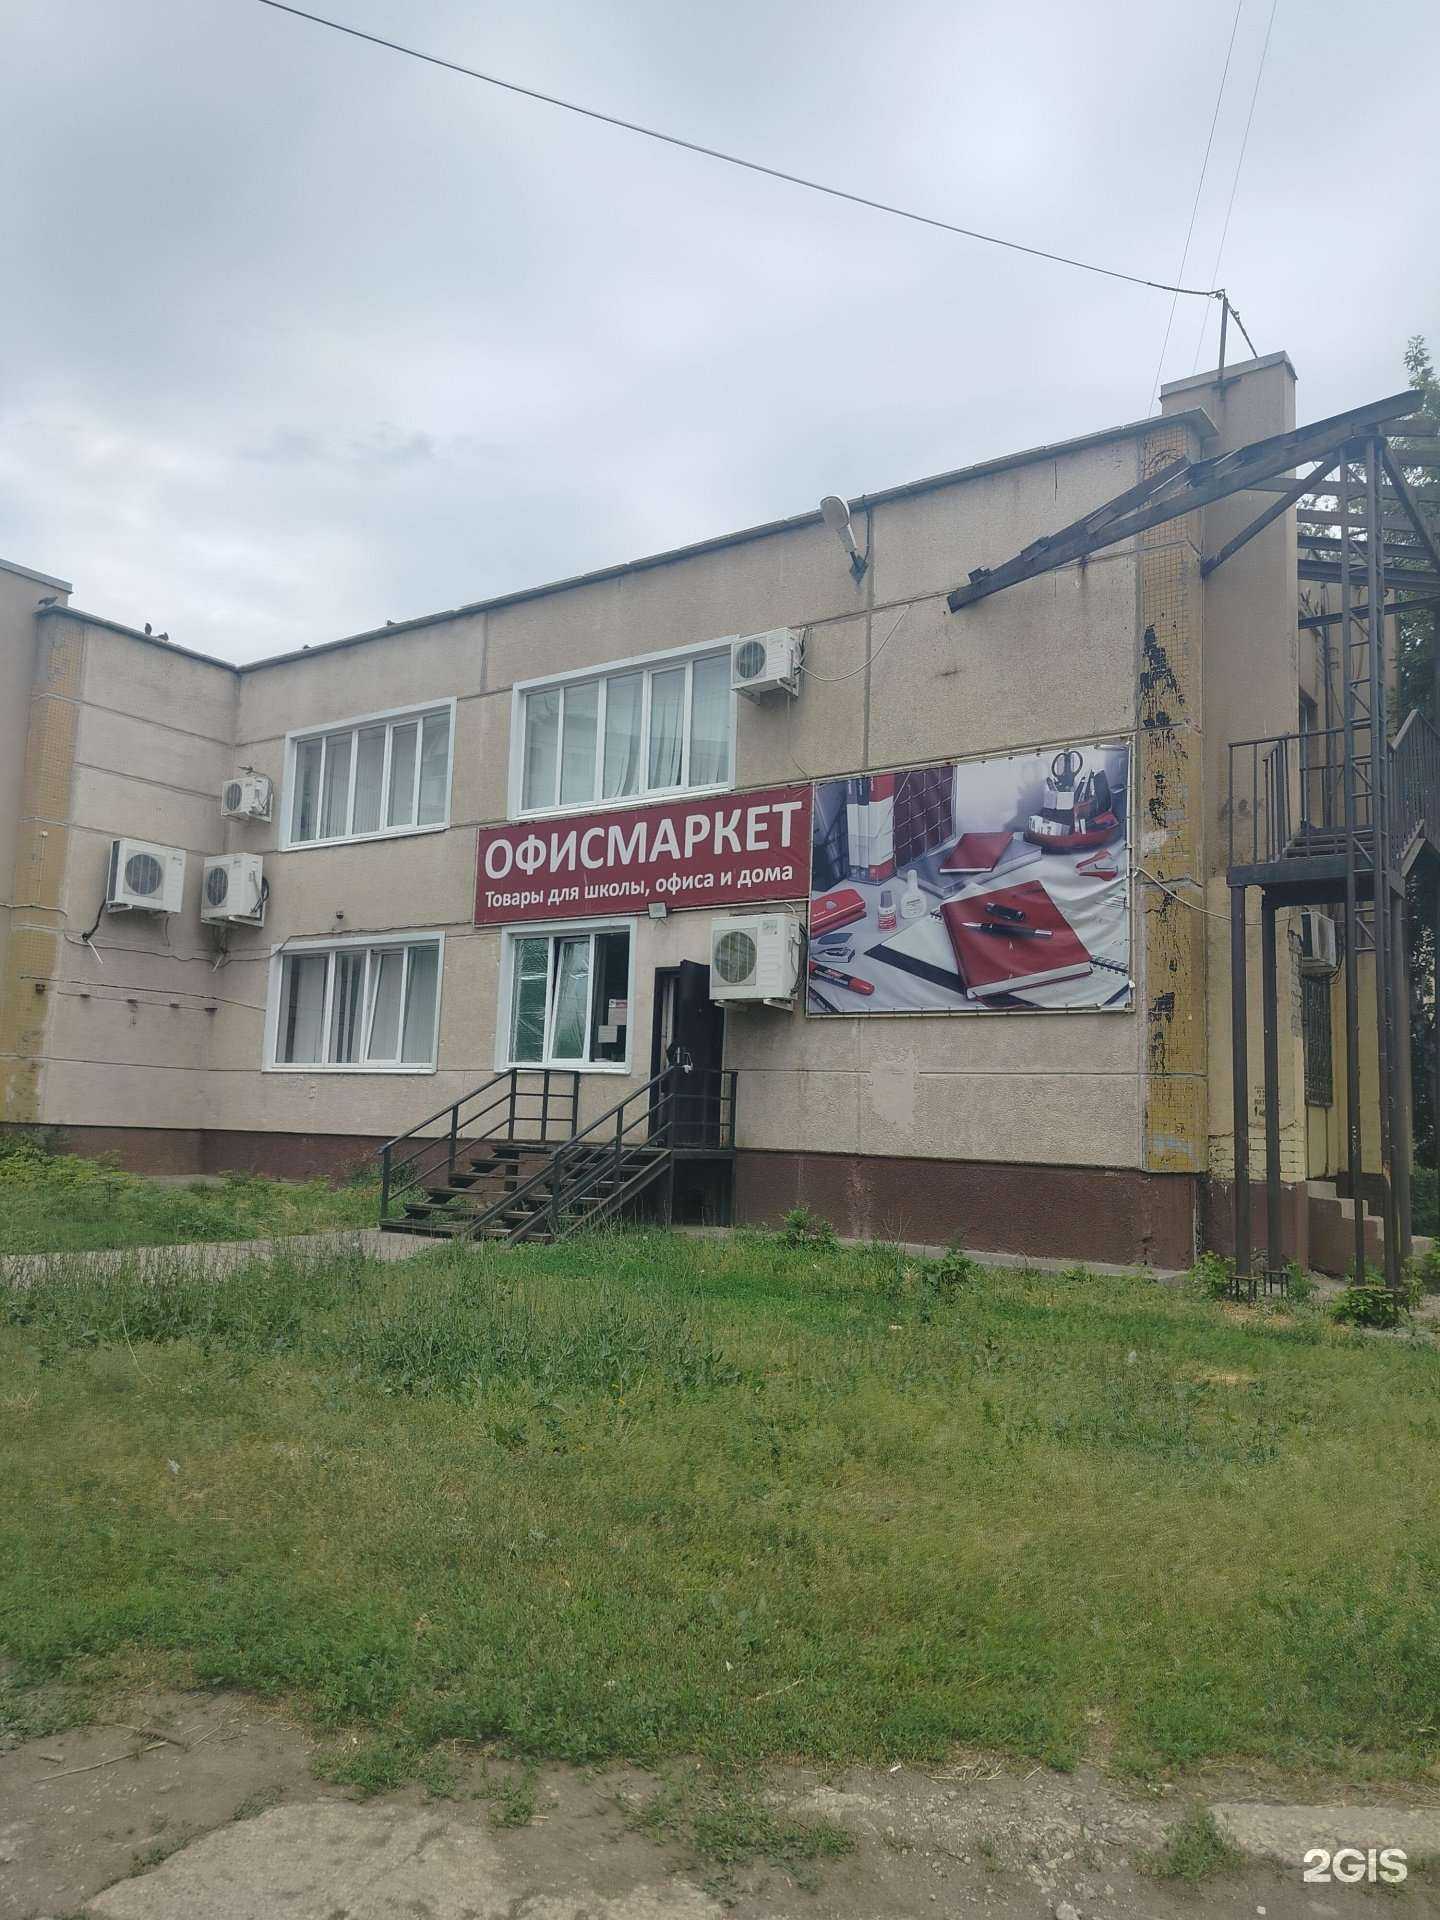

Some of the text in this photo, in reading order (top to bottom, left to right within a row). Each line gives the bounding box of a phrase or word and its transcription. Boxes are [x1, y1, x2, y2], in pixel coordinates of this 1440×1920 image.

[484, 801, 802, 880] ОФИСМАРКЕТ
[485, 864, 793, 908] Товары для школы, офиса и дома
